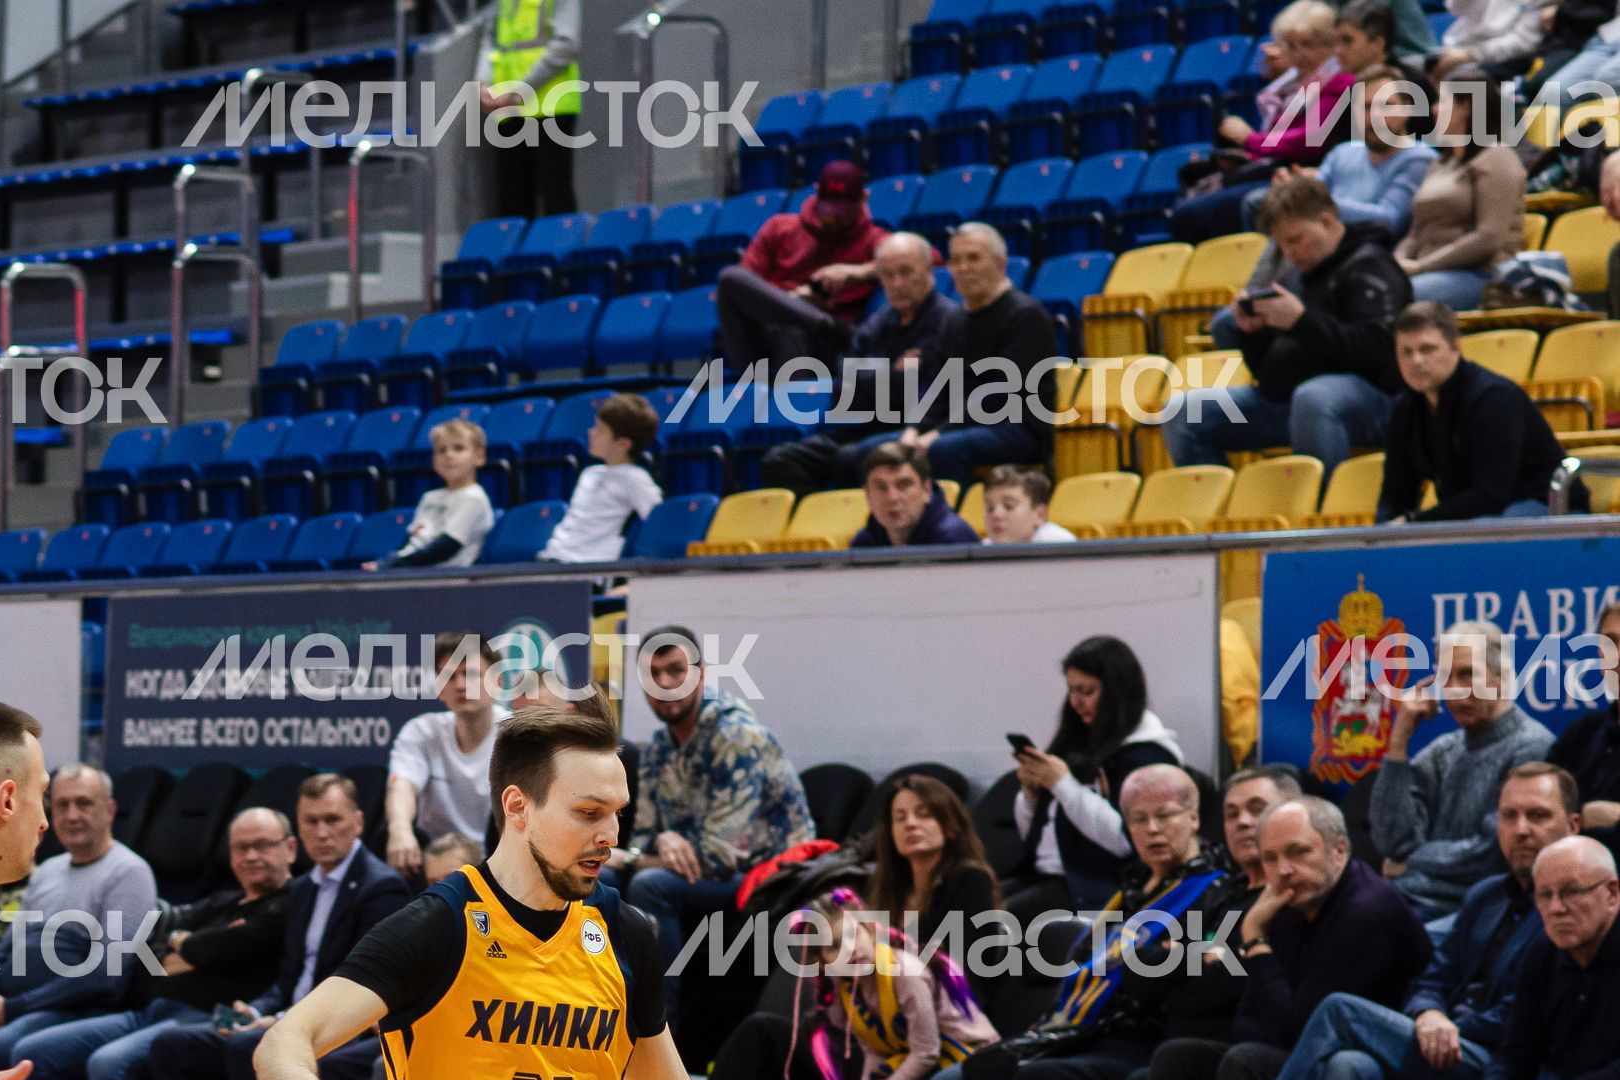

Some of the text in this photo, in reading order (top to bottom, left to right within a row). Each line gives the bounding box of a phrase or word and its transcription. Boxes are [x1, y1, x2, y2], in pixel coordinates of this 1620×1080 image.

[124, 668, 187, 700] КОГДА
[123, 716, 391, 748] ВАЖНЕЕ ВСЕГО ОСТАЛЬНОГО
[464, 998, 621, 1052] ХИМКИ
